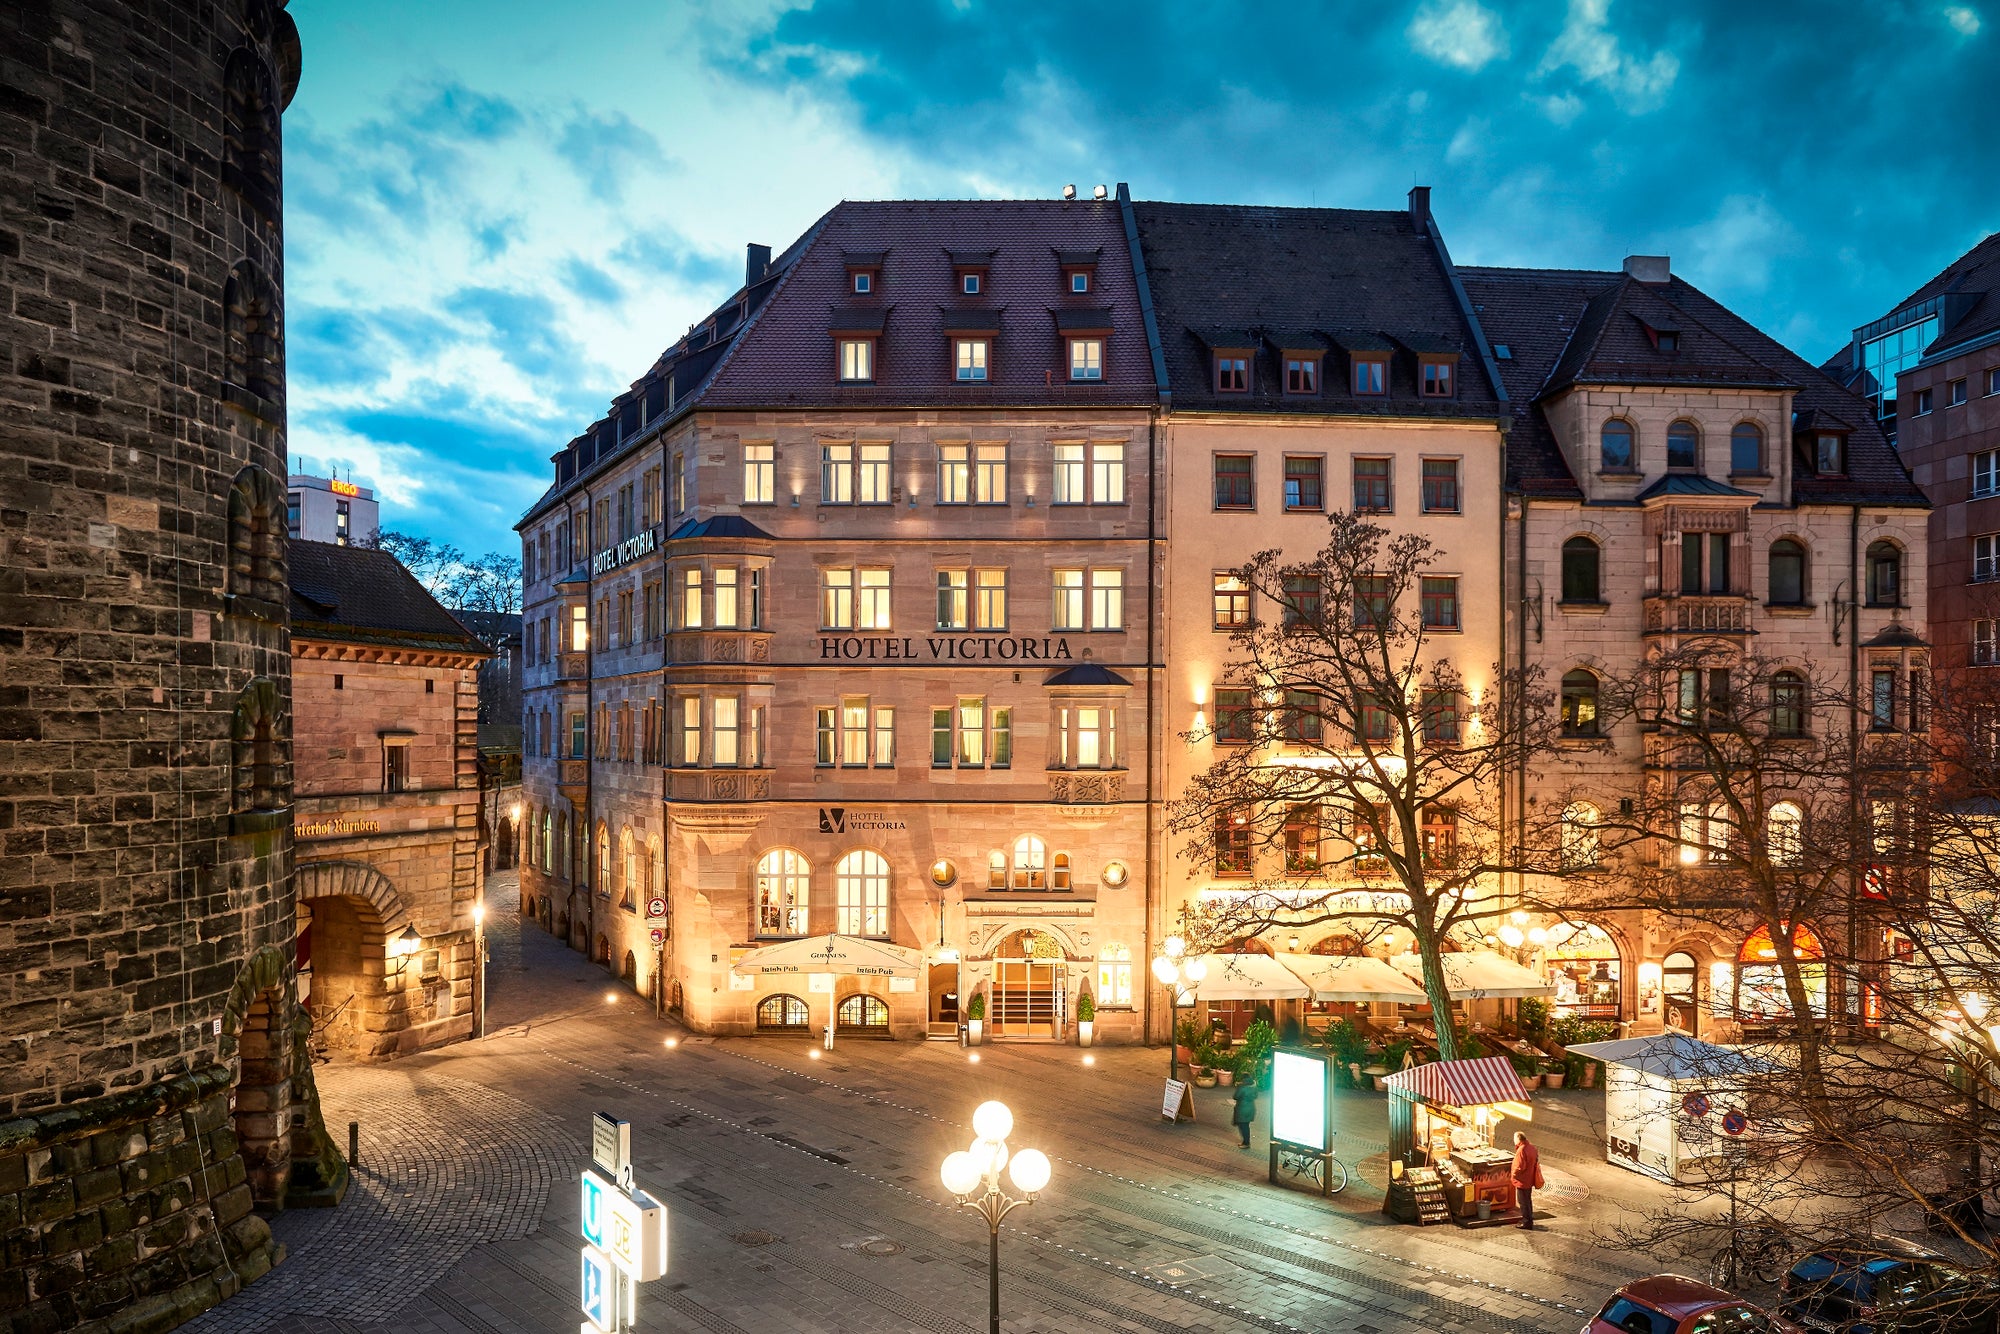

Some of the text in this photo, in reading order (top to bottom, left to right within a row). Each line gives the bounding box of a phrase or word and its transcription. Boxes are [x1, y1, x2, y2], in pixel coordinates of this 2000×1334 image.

[331, 480, 357, 497] ERGO
[593, 529, 655, 576] HOTEL VICTORIA
[820, 638, 1073, 659] HOTEL VICTORIA
[850, 813, 876, 821] HOTEL
[850, 822, 906, 830] VICTORIA
[783, 965, 799, 973] Pub
[878, 967, 894, 975] Pub
[614, 1219, 630, 1255] DB
